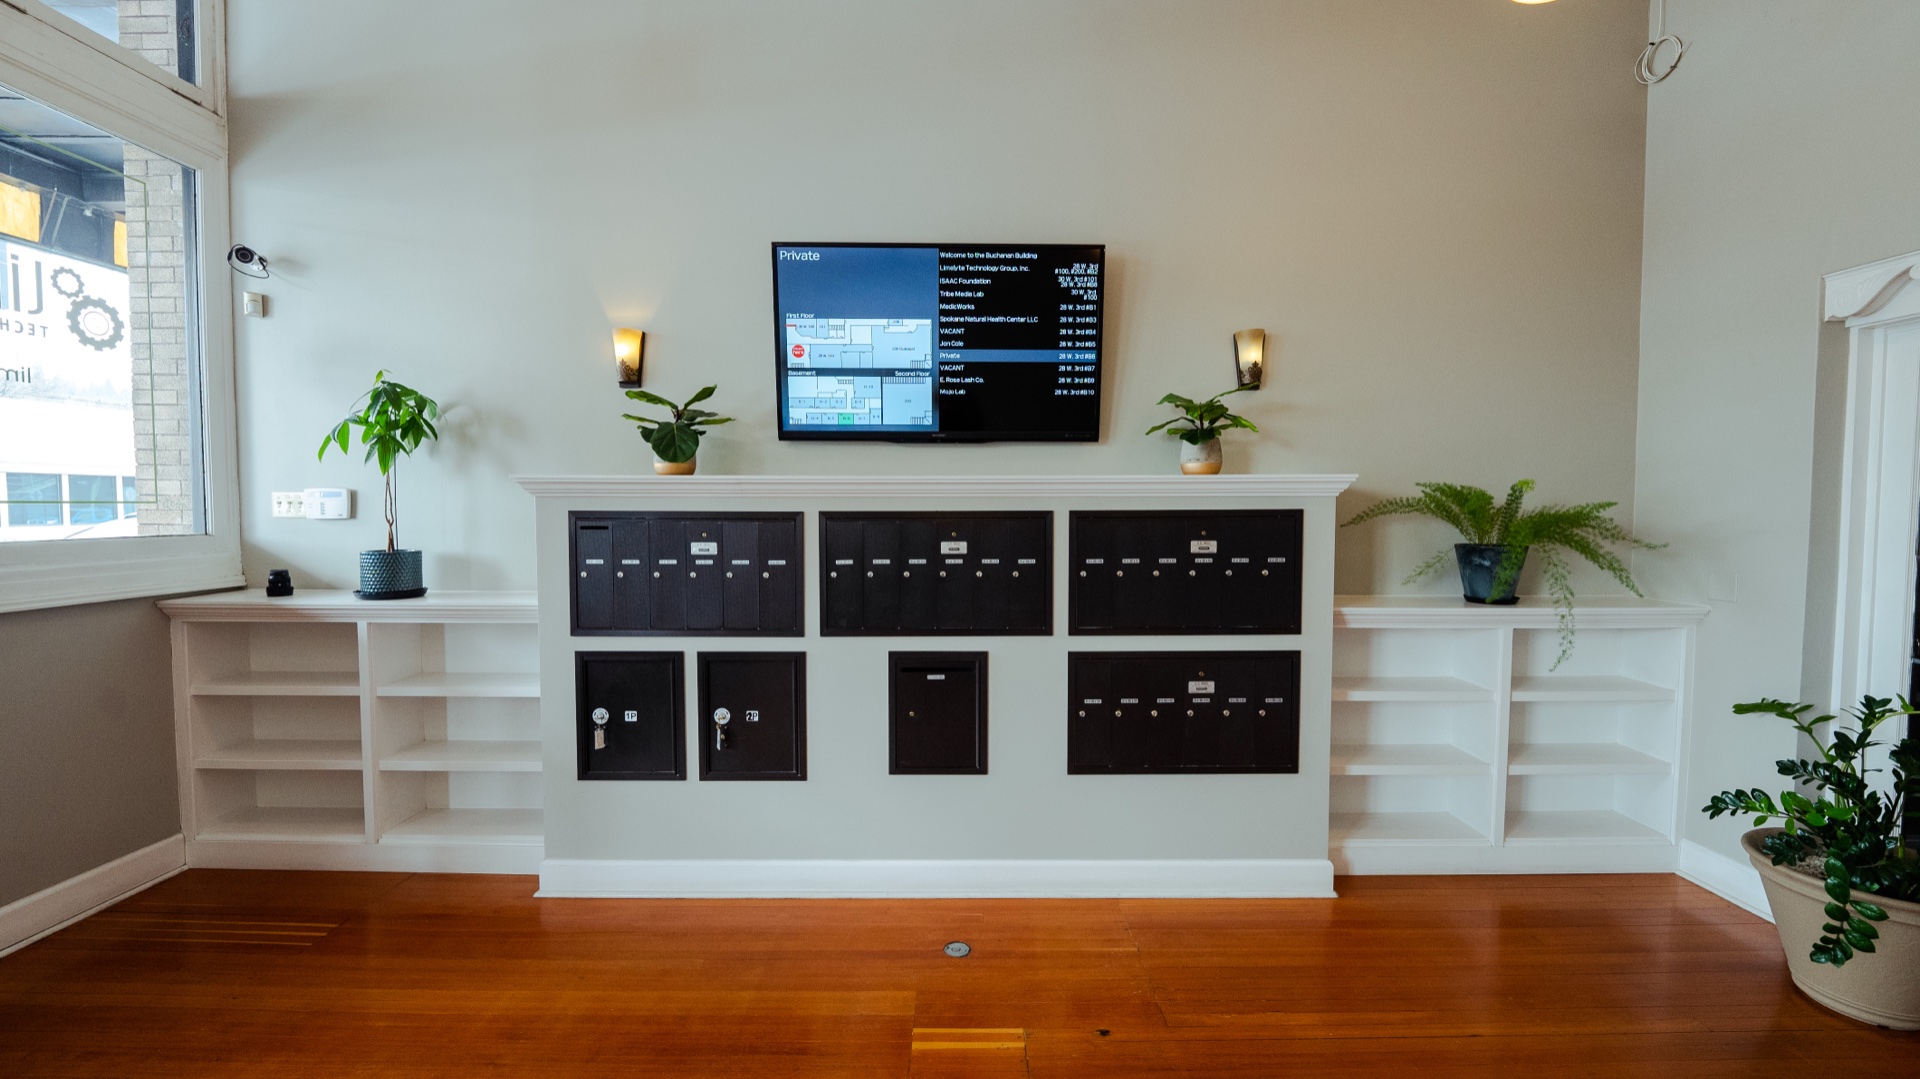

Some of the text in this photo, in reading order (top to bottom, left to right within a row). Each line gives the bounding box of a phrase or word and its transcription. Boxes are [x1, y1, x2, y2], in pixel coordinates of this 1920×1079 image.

[780, 250, 820, 260] Private
[626, 712, 637, 720] 1P
[746, 712, 758, 720] 2P
